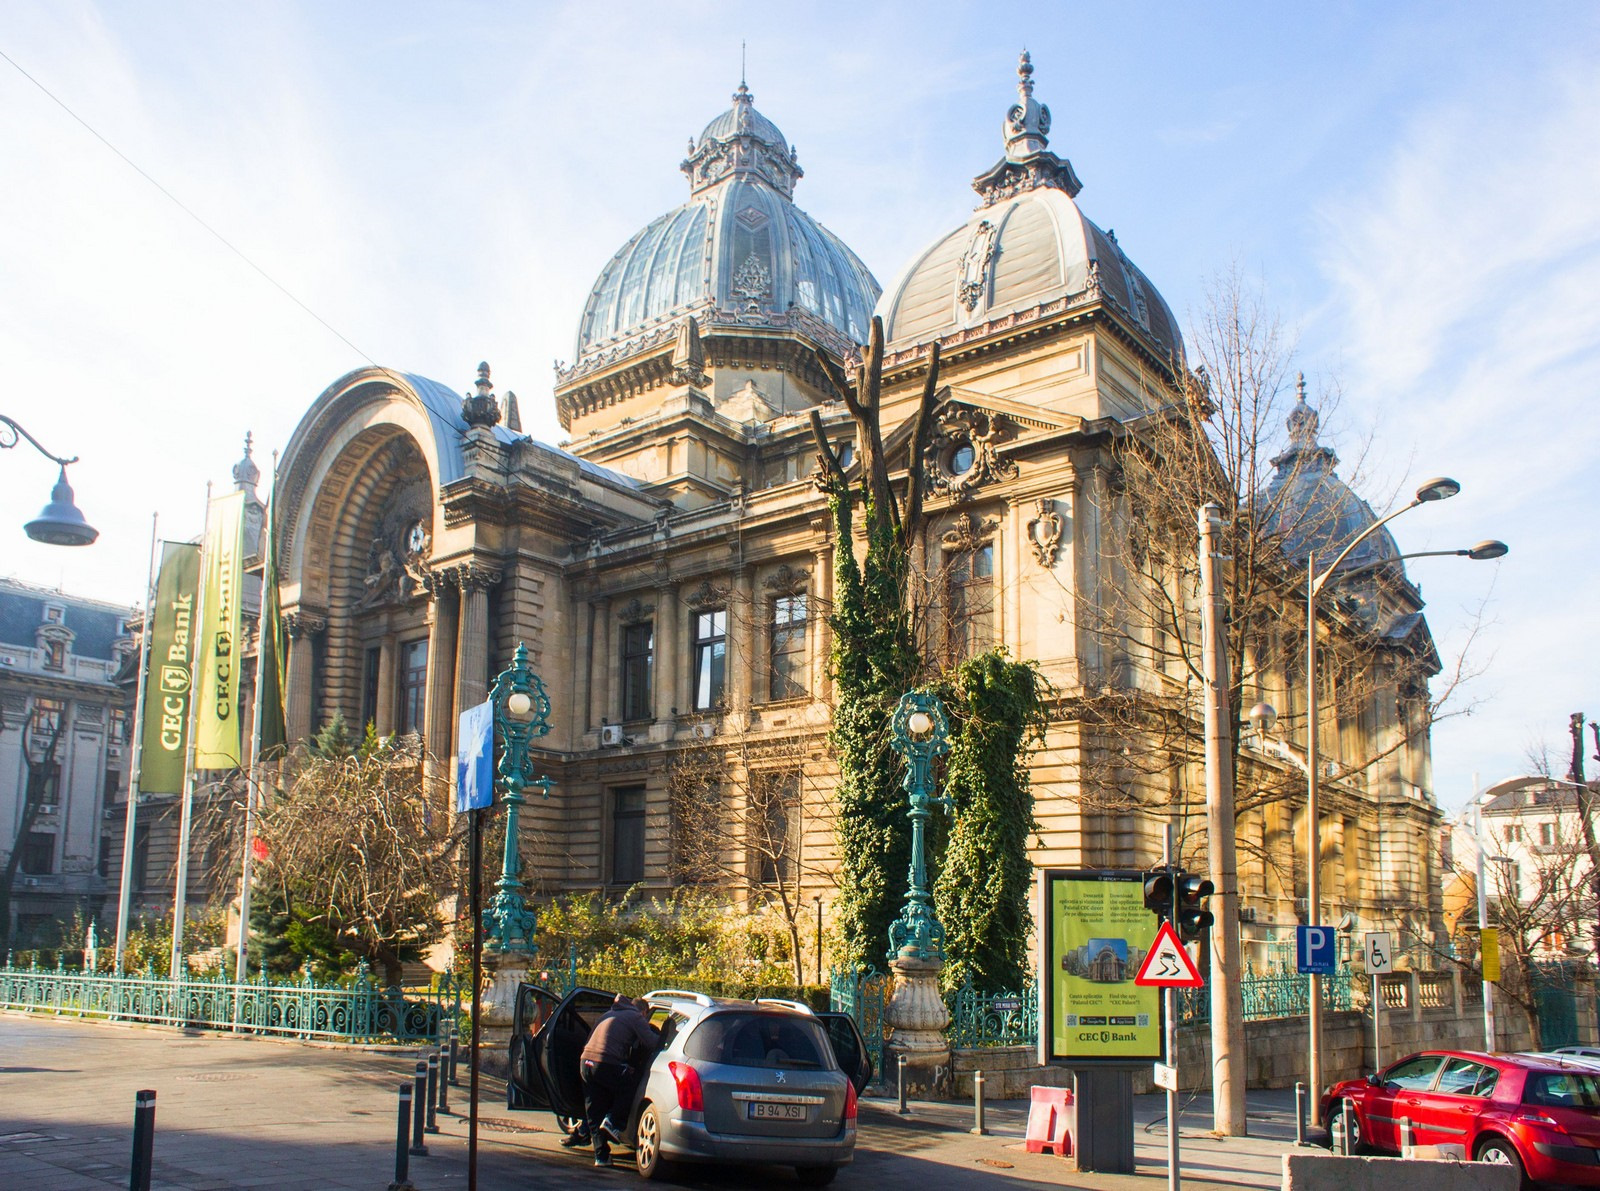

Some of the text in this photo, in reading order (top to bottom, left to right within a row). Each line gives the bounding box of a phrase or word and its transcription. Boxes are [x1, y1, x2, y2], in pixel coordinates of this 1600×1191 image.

[160, 592, 192, 751] CEC Bank
[216, 663, 231, 721] CEC
[1306, 928, 1325, 966] P
[1079, 1032, 1137, 1042] CEC Bank
[757, 1105, 800, 1118] B 94 XSI
